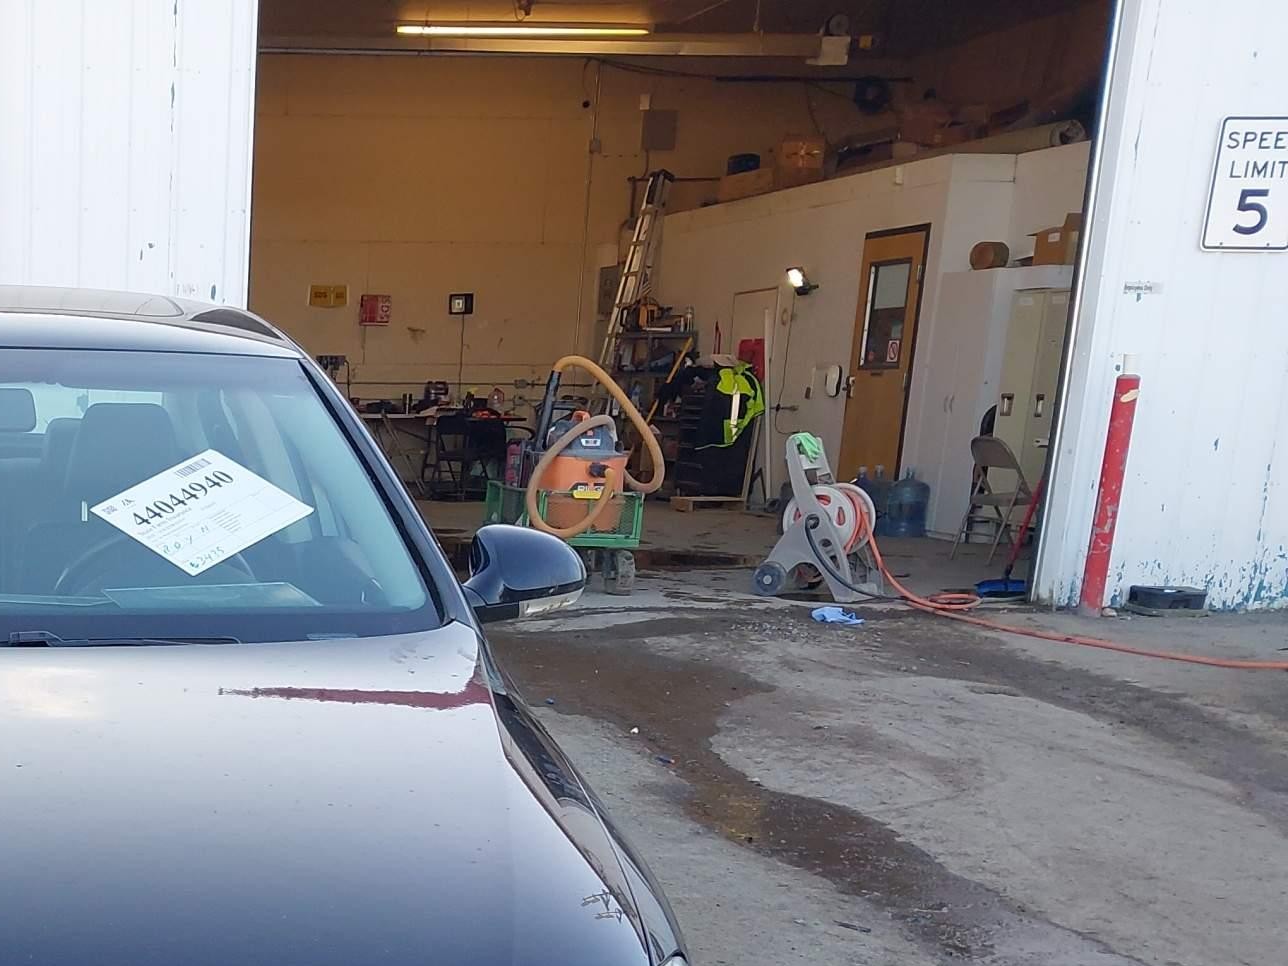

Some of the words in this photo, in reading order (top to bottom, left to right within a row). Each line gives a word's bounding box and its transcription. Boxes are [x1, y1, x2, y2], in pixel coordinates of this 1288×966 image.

[1229, 160, 1288, 179] LIMIT
[1232, 188, 1270, 236] 5
[133, 470, 234, 527] 44044940
